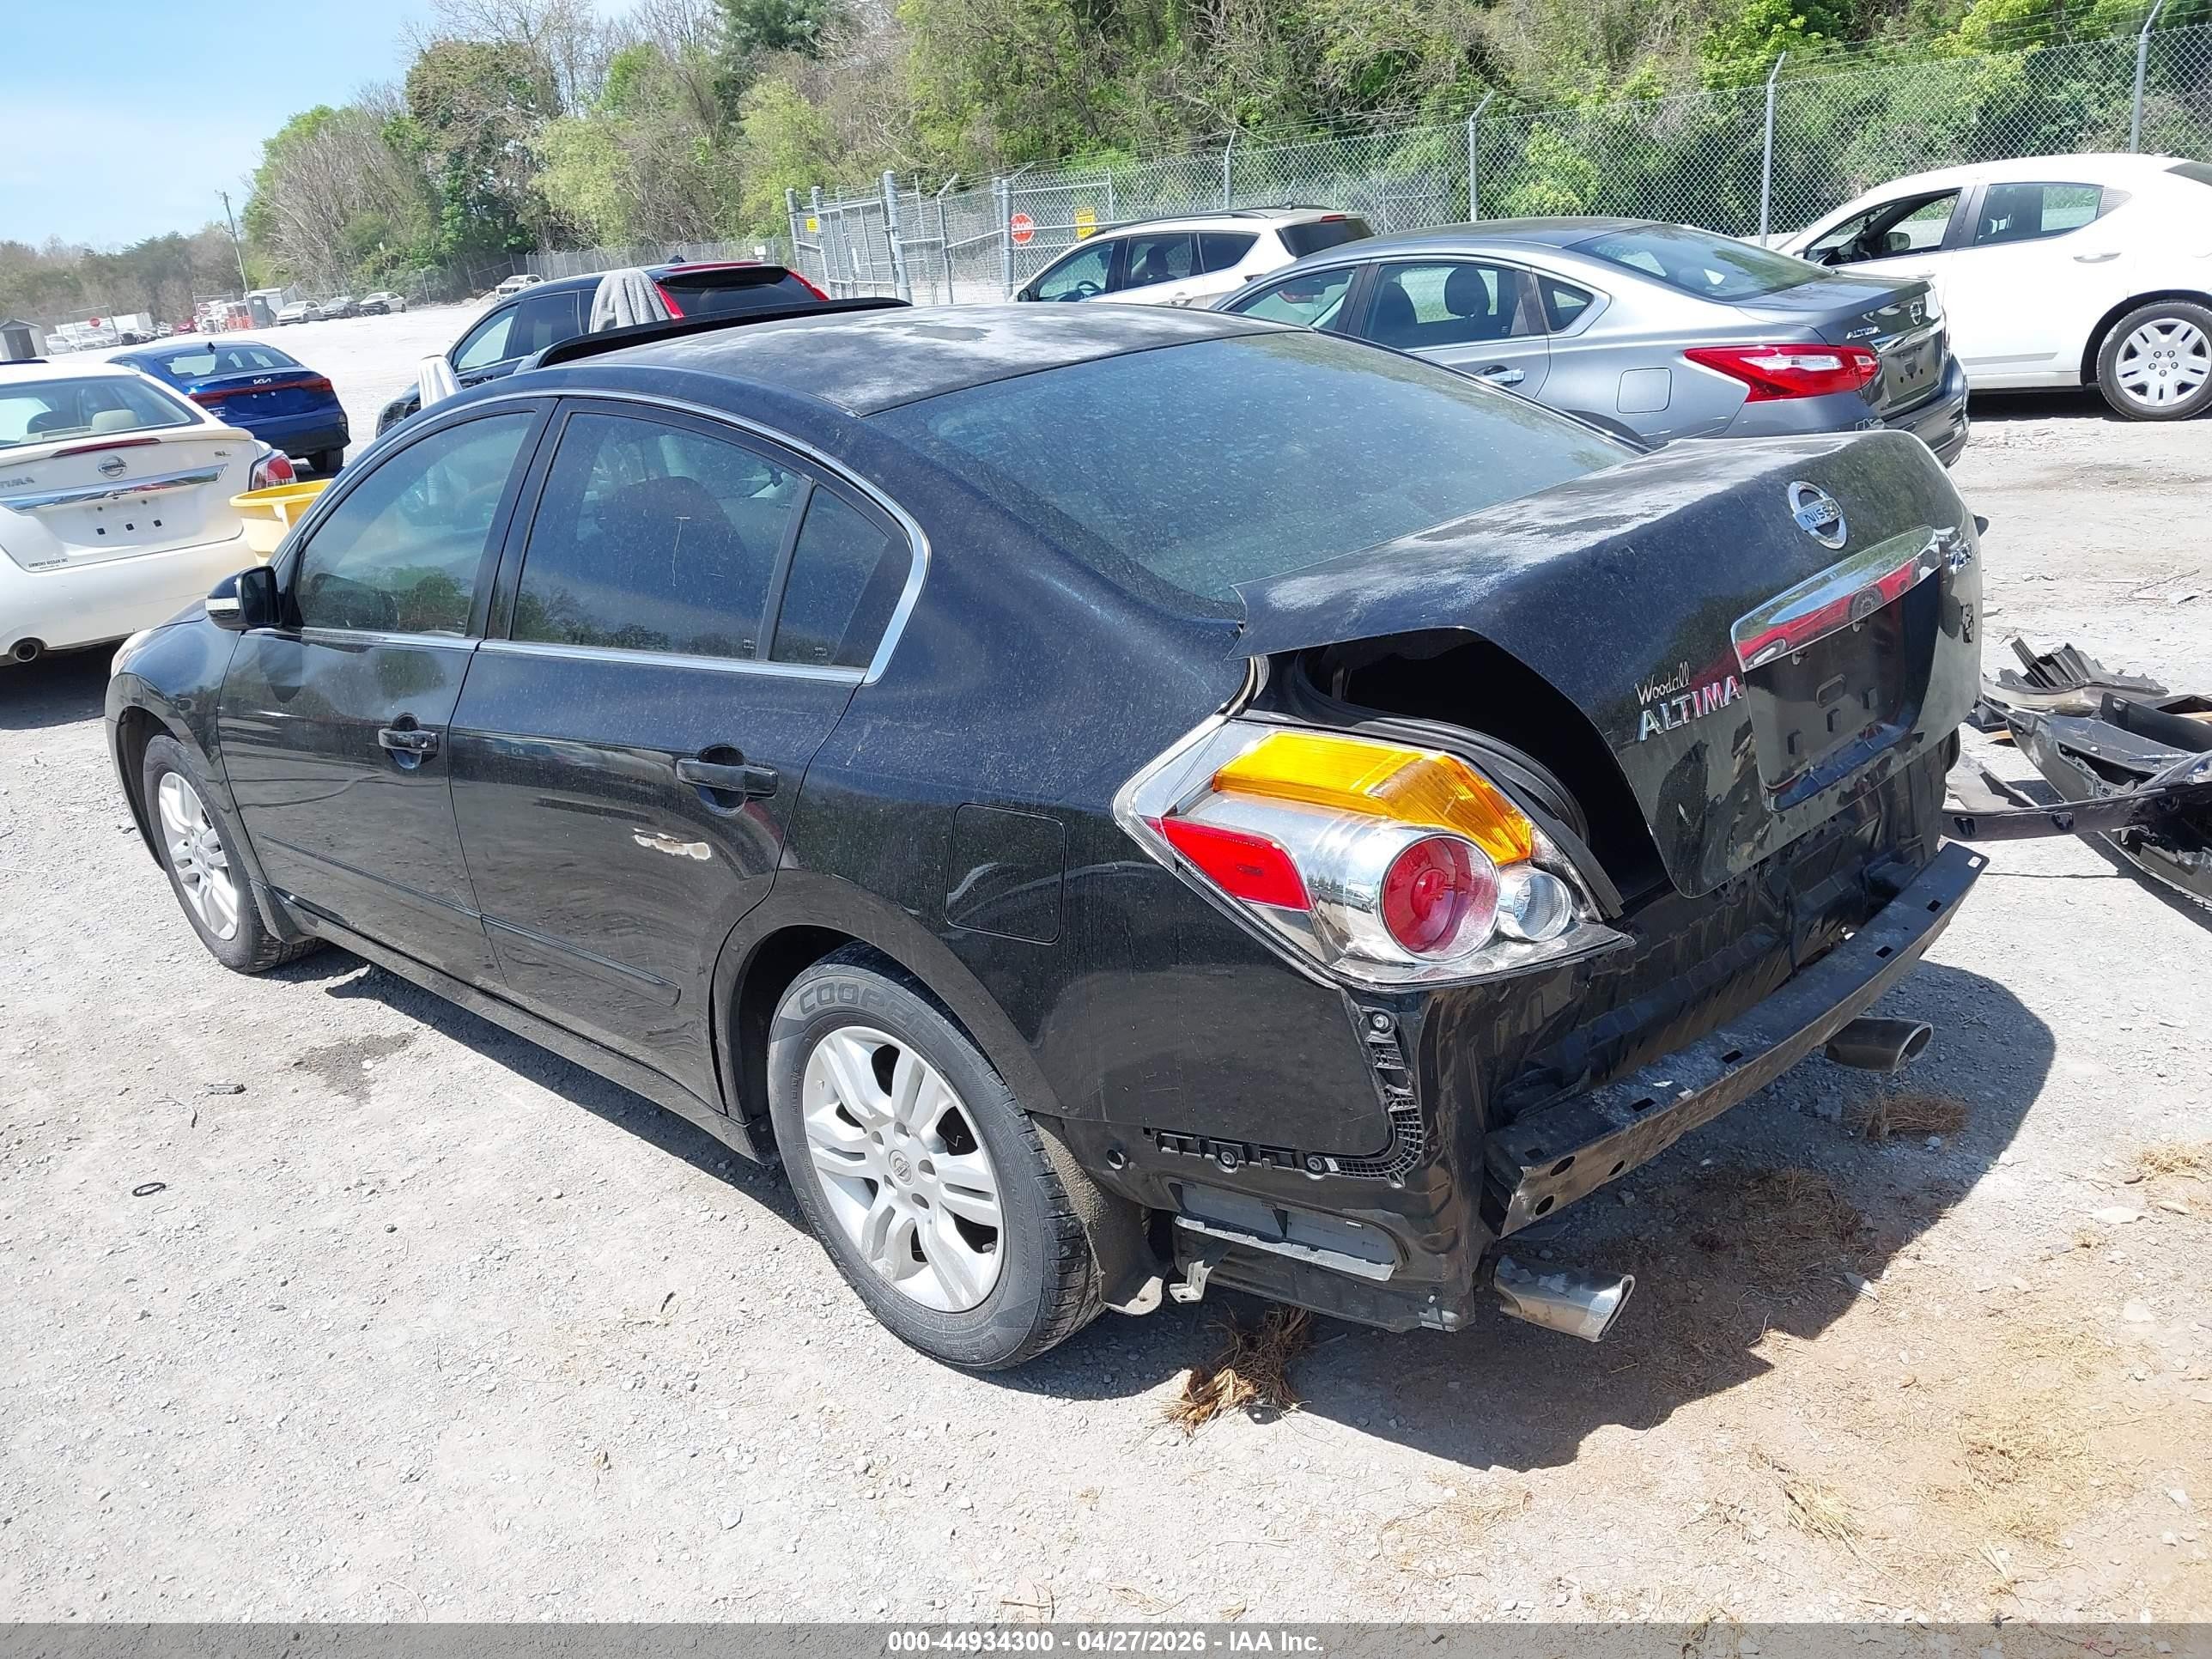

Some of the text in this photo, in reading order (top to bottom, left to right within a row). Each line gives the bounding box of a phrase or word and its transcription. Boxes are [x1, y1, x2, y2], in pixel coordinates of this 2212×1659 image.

[1634, 660, 1691, 707] Woodall
[1636, 675, 1745, 742] ALTIMA
[799, 981, 941, 1046] COOPER
